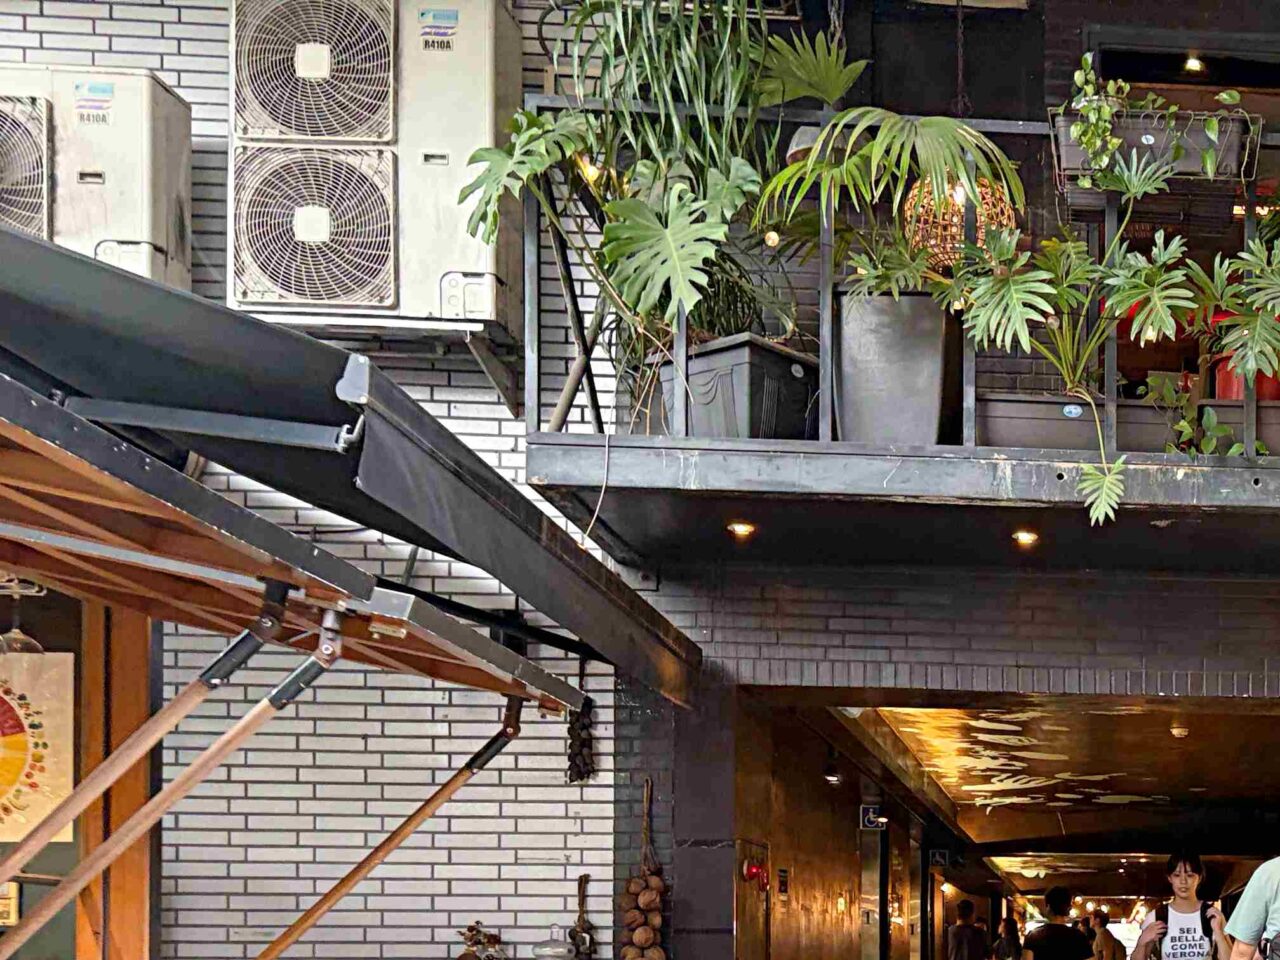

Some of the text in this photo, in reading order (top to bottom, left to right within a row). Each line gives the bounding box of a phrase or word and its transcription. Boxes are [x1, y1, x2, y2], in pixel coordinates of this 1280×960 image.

[424, 39, 452, 50] R410A
[79, 112, 108, 123] R410A
[1179, 926, 1197, 935] SEI
[1170, 935, 1206, 944] BELLA
[1170, 942, 1206, 951] COME
